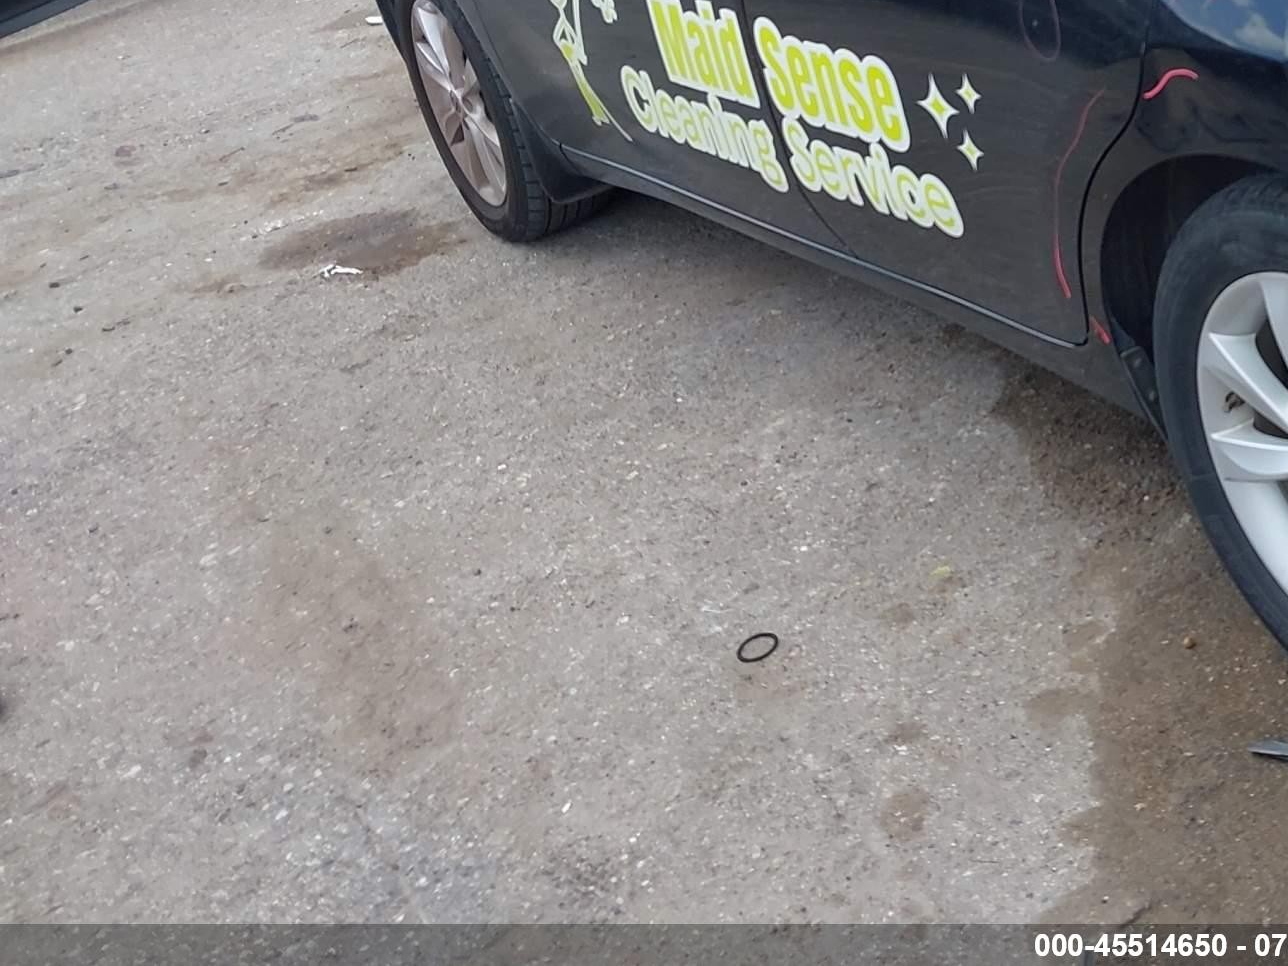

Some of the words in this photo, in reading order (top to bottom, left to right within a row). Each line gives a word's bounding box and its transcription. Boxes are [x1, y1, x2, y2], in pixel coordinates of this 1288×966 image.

[620, 65, 789, 193] Cleaning
[781, 117, 964, 237] Service
[752, 16, 910, 152] Sense
